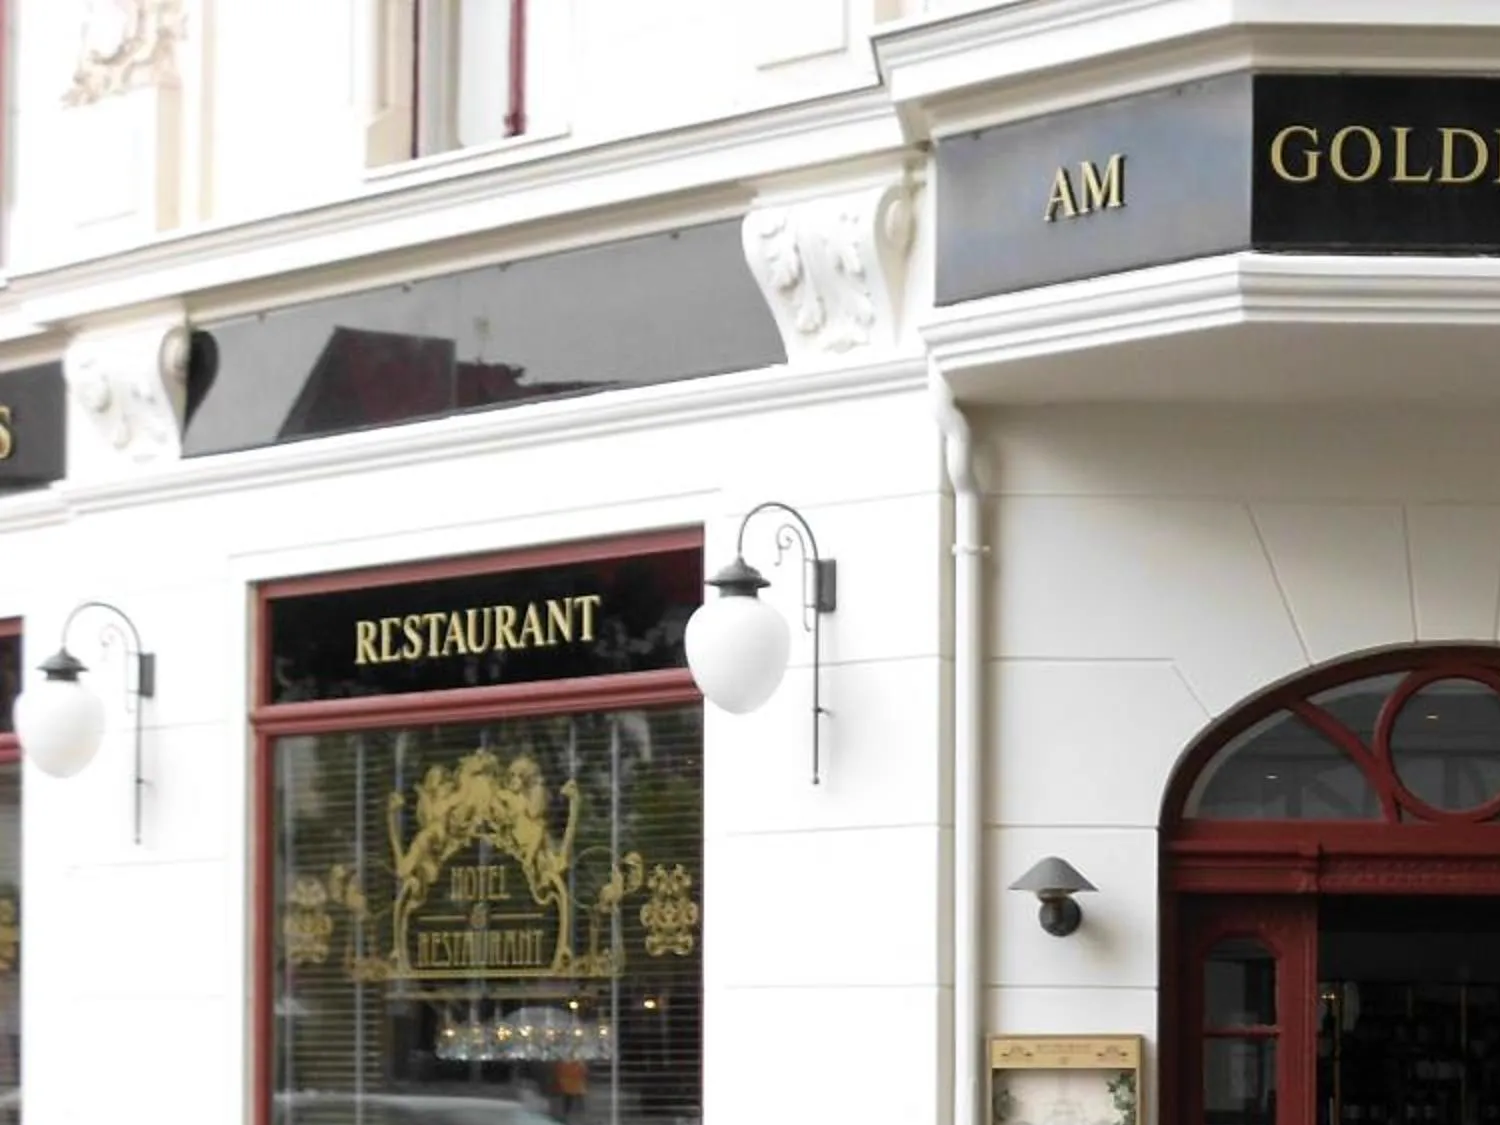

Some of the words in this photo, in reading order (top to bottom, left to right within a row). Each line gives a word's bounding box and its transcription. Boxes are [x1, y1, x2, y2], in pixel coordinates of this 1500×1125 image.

[1044, 153, 1127, 222] AM
[355, 595, 600, 665] RESTAURANT
[450, 865, 512, 900] HOTEL
[417, 929, 544, 967] RESTAURANT
